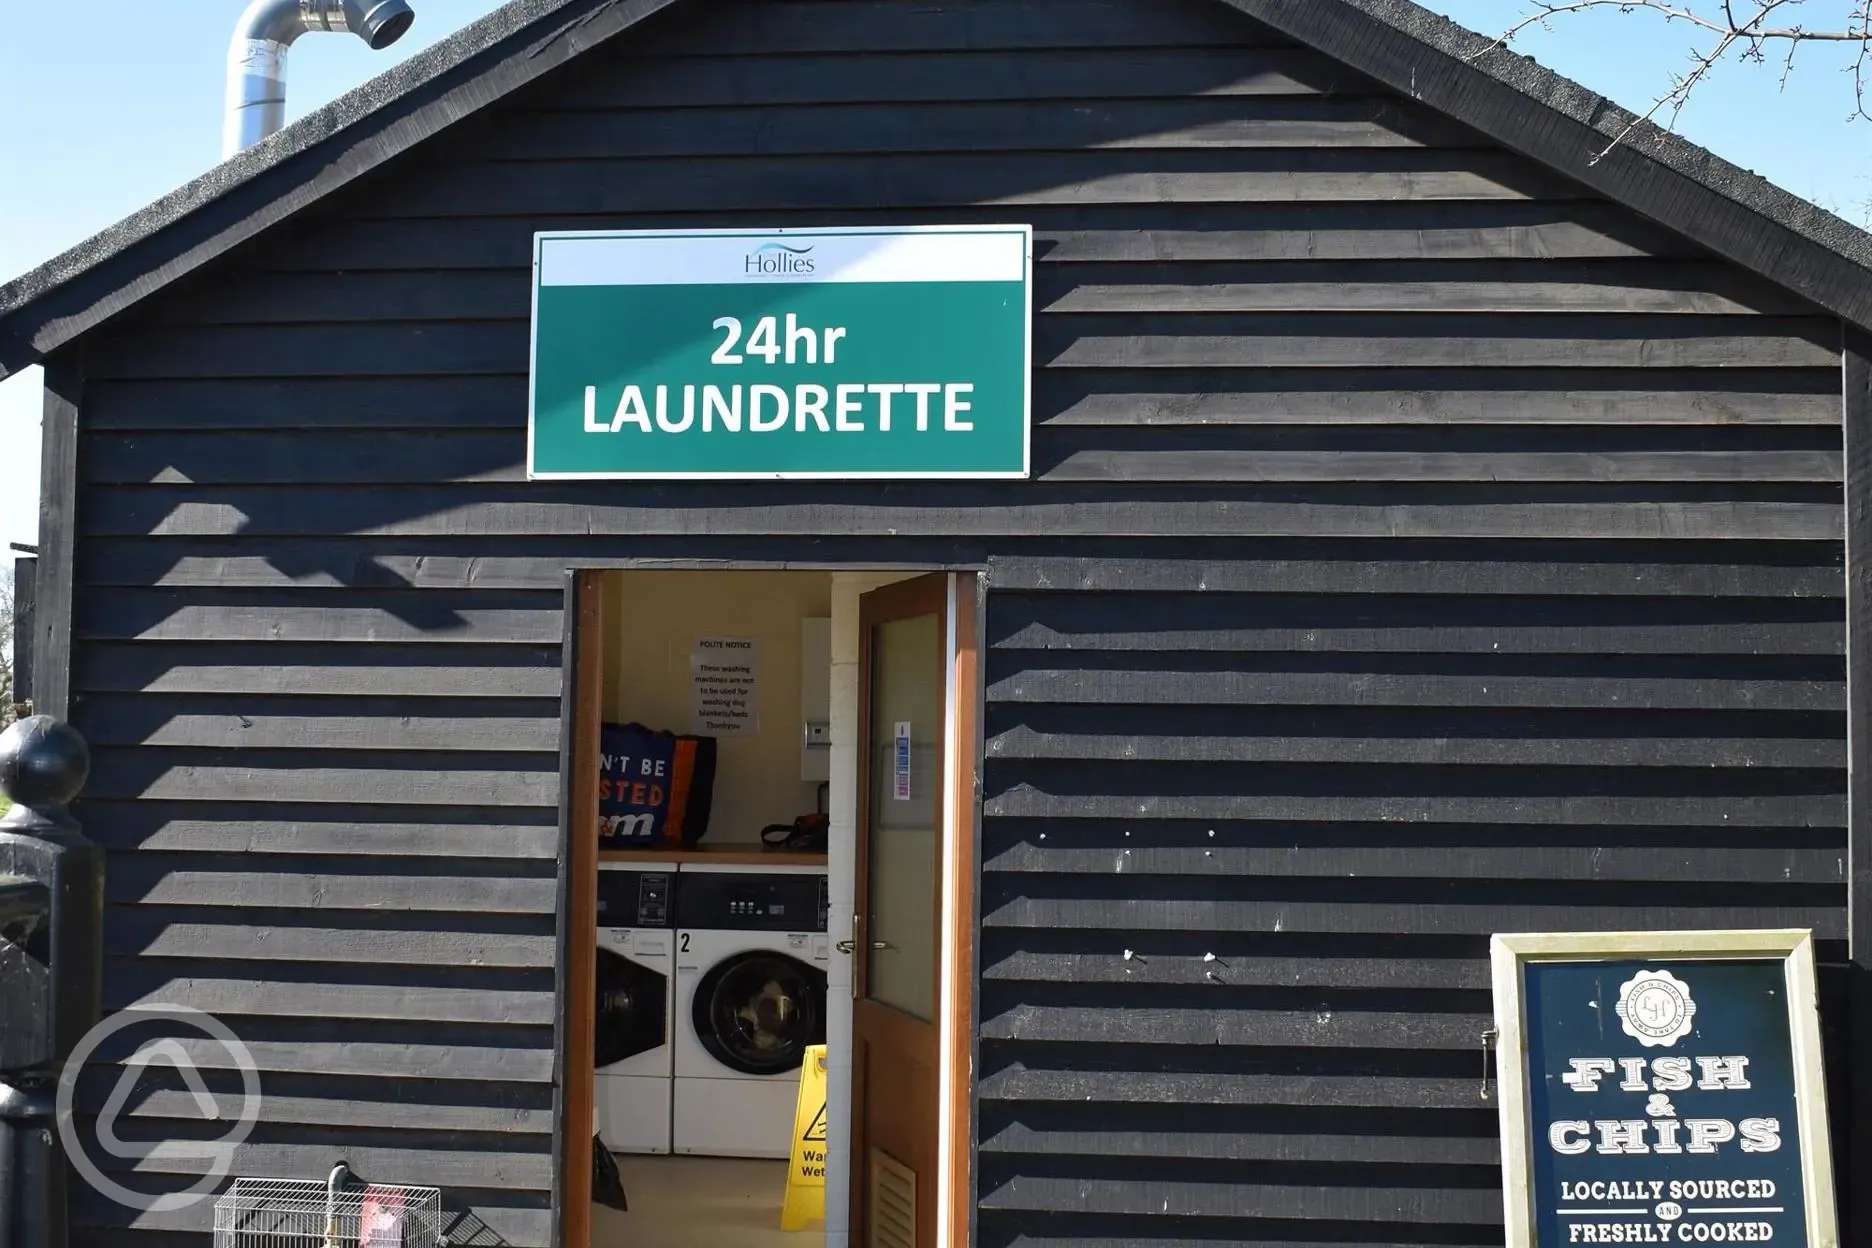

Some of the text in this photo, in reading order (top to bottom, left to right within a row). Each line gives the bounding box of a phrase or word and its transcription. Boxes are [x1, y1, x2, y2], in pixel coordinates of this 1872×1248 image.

[745, 252, 815, 273] Hollies
[711, 313, 846, 365] 24hr
[584, 383, 974, 433] LAUNDRETTE
[700, 640, 751, 649] POLITE NOTICE
[700, 664, 751, 674] These washing
[694, 676, 728, 684] machines
[737, 687, 748, 695] for
[702, 699, 731, 708] washing
[599, 753, 666, 777] N'T BE
[598, 778, 665, 807] STED
[681, 932, 690, 953] 2
[1565, 1056, 1751, 1092] FISH
[1645, 1093, 1677, 1117] &
[1548, 1118, 1782, 1155] CHIPS
[801, 1165, 825, 1177] Wet
[1561, 1179, 1776, 1200] LOCALLY SOURCED
[1658, 1205, 1680, 1216] AND
[1569, 1222, 1774, 1243] FRESHLY COOKED
